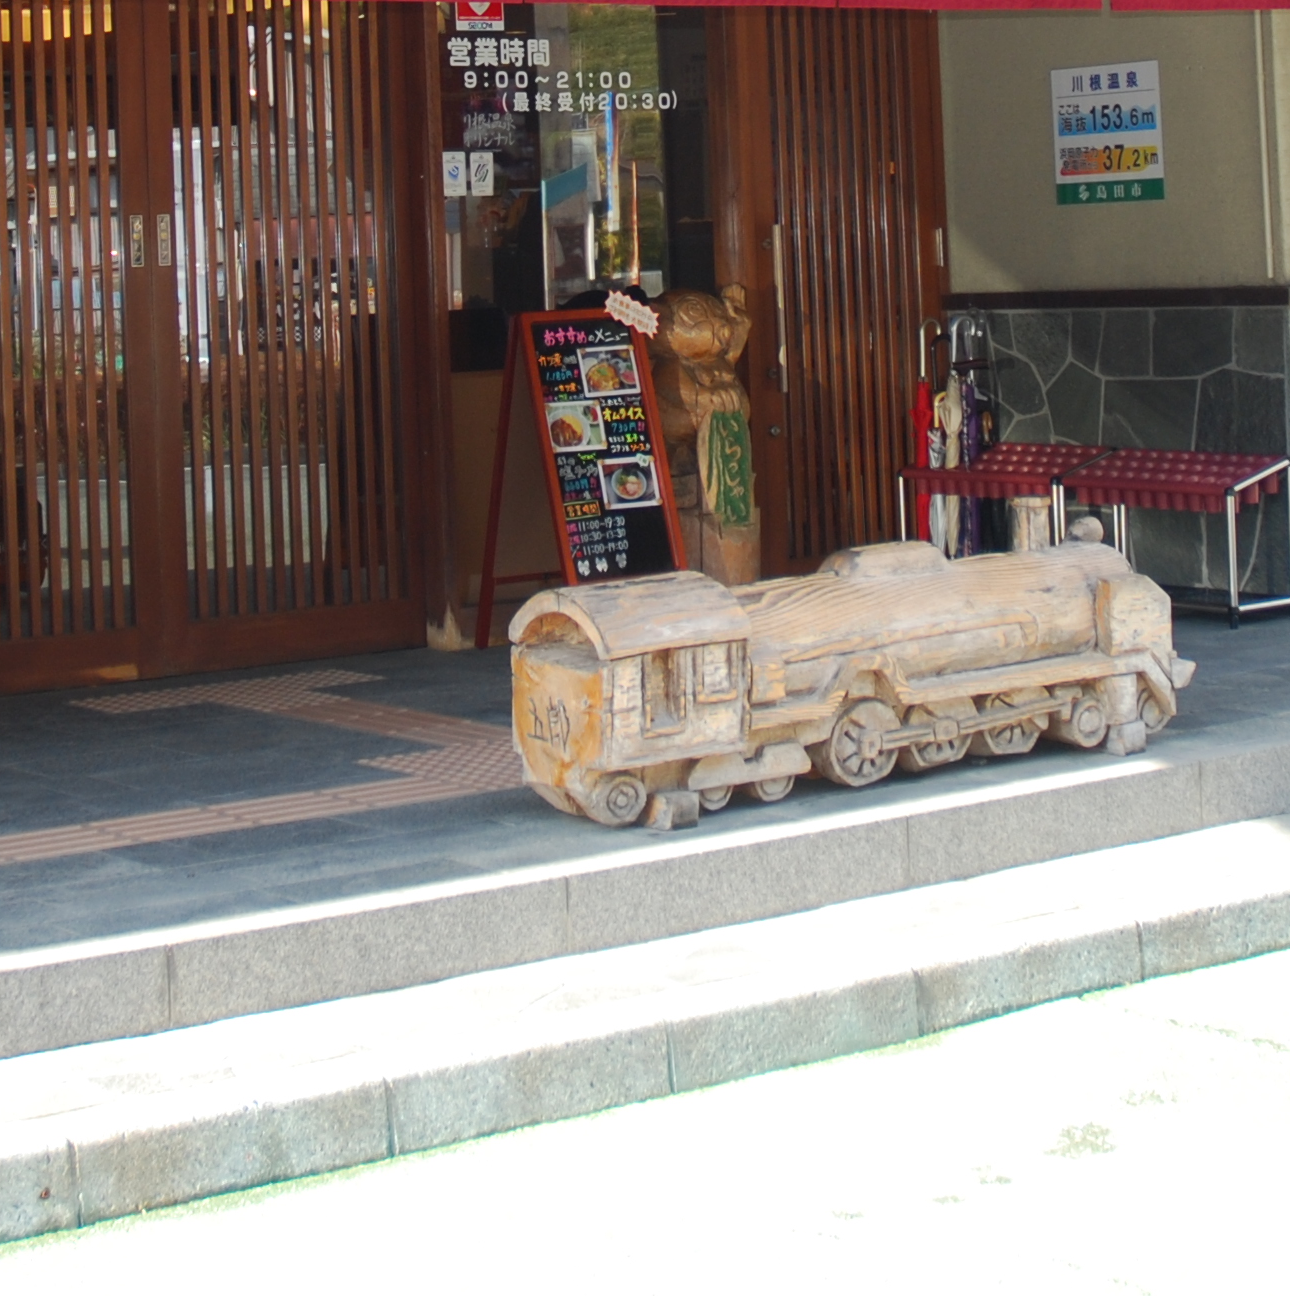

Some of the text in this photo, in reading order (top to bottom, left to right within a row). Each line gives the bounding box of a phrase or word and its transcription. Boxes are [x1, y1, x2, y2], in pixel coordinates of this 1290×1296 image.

[447, 37, 551, 67] 営業時間
[1071, 70, 1139, 93] 川根温泉
[1058, 104, 1081, 116] ここは
[1089, 104, 1155, 132] 153.6m
[1060, 117, 1087, 134] 海抜
[602, 406, 646, 422] オムライス
